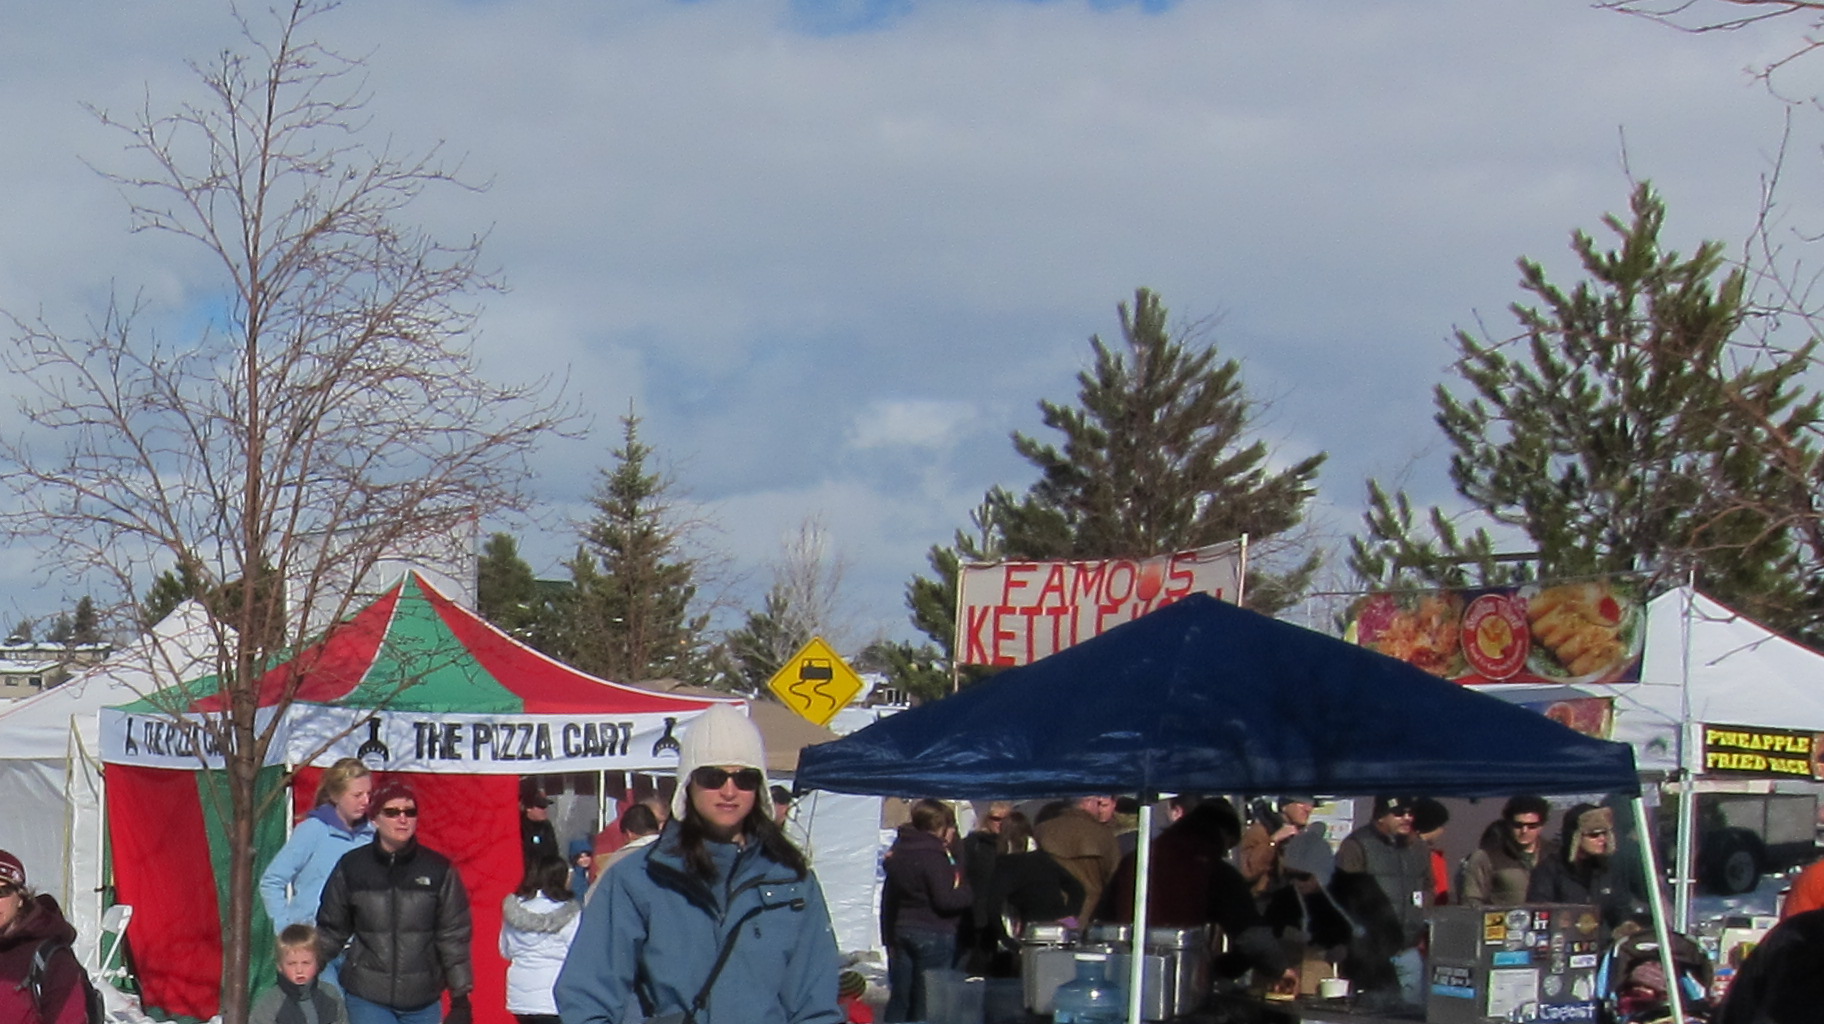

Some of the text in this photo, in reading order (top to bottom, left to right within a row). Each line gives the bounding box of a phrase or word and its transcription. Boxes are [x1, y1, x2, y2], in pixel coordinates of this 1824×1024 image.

[413, 722, 634, 760] THE PIZZA CART
[1706, 729, 1809, 753] PINEAPPLE
[1706, 752, 1767, 770] FRIED
